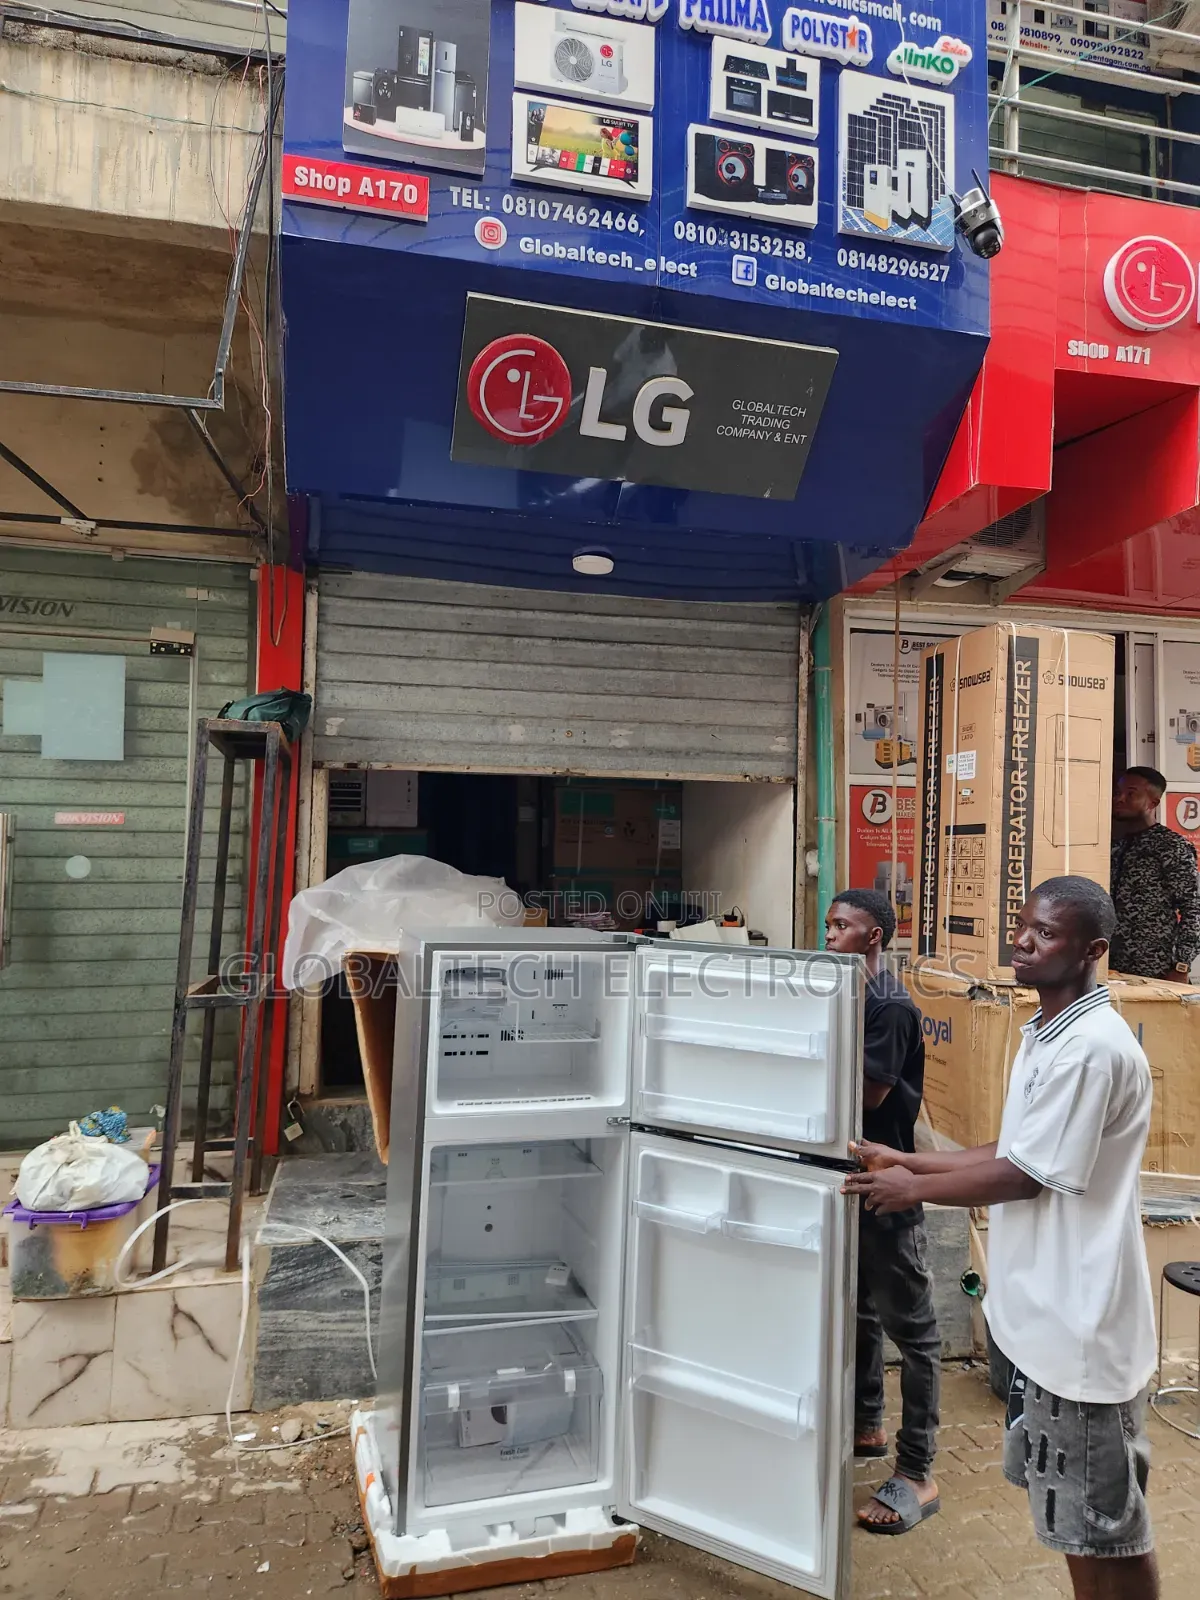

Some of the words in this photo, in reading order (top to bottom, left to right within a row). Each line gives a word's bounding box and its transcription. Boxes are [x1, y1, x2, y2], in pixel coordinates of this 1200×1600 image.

[990, 21, 1063, 45] 089810899,
[601, 58, 613, 68] LG
[294, 166, 351, 197] Shop
[358, 176, 418, 204] A170
[450, 186, 491, 211] TEL:
[502, 193, 645, 237] 08107462466,
[673, 220, 812, 264] 08103153258,
[837, 248, 950, 283] 08148296527
[765, 274, 917, 310] Globaltechelect
[1067, 339, 1109, 359] Shop
[1115, 345, 1151, 365] A171
[579, 366, 695, 447] LG
[732, 400, 807, 418] GLOBALTECH
[716, 425, 773, 441] COMPANY
[773, 432, 782, 443] &
[783, 433, 808, 445] ENT
[741, 414, 791, 430] TRADING
